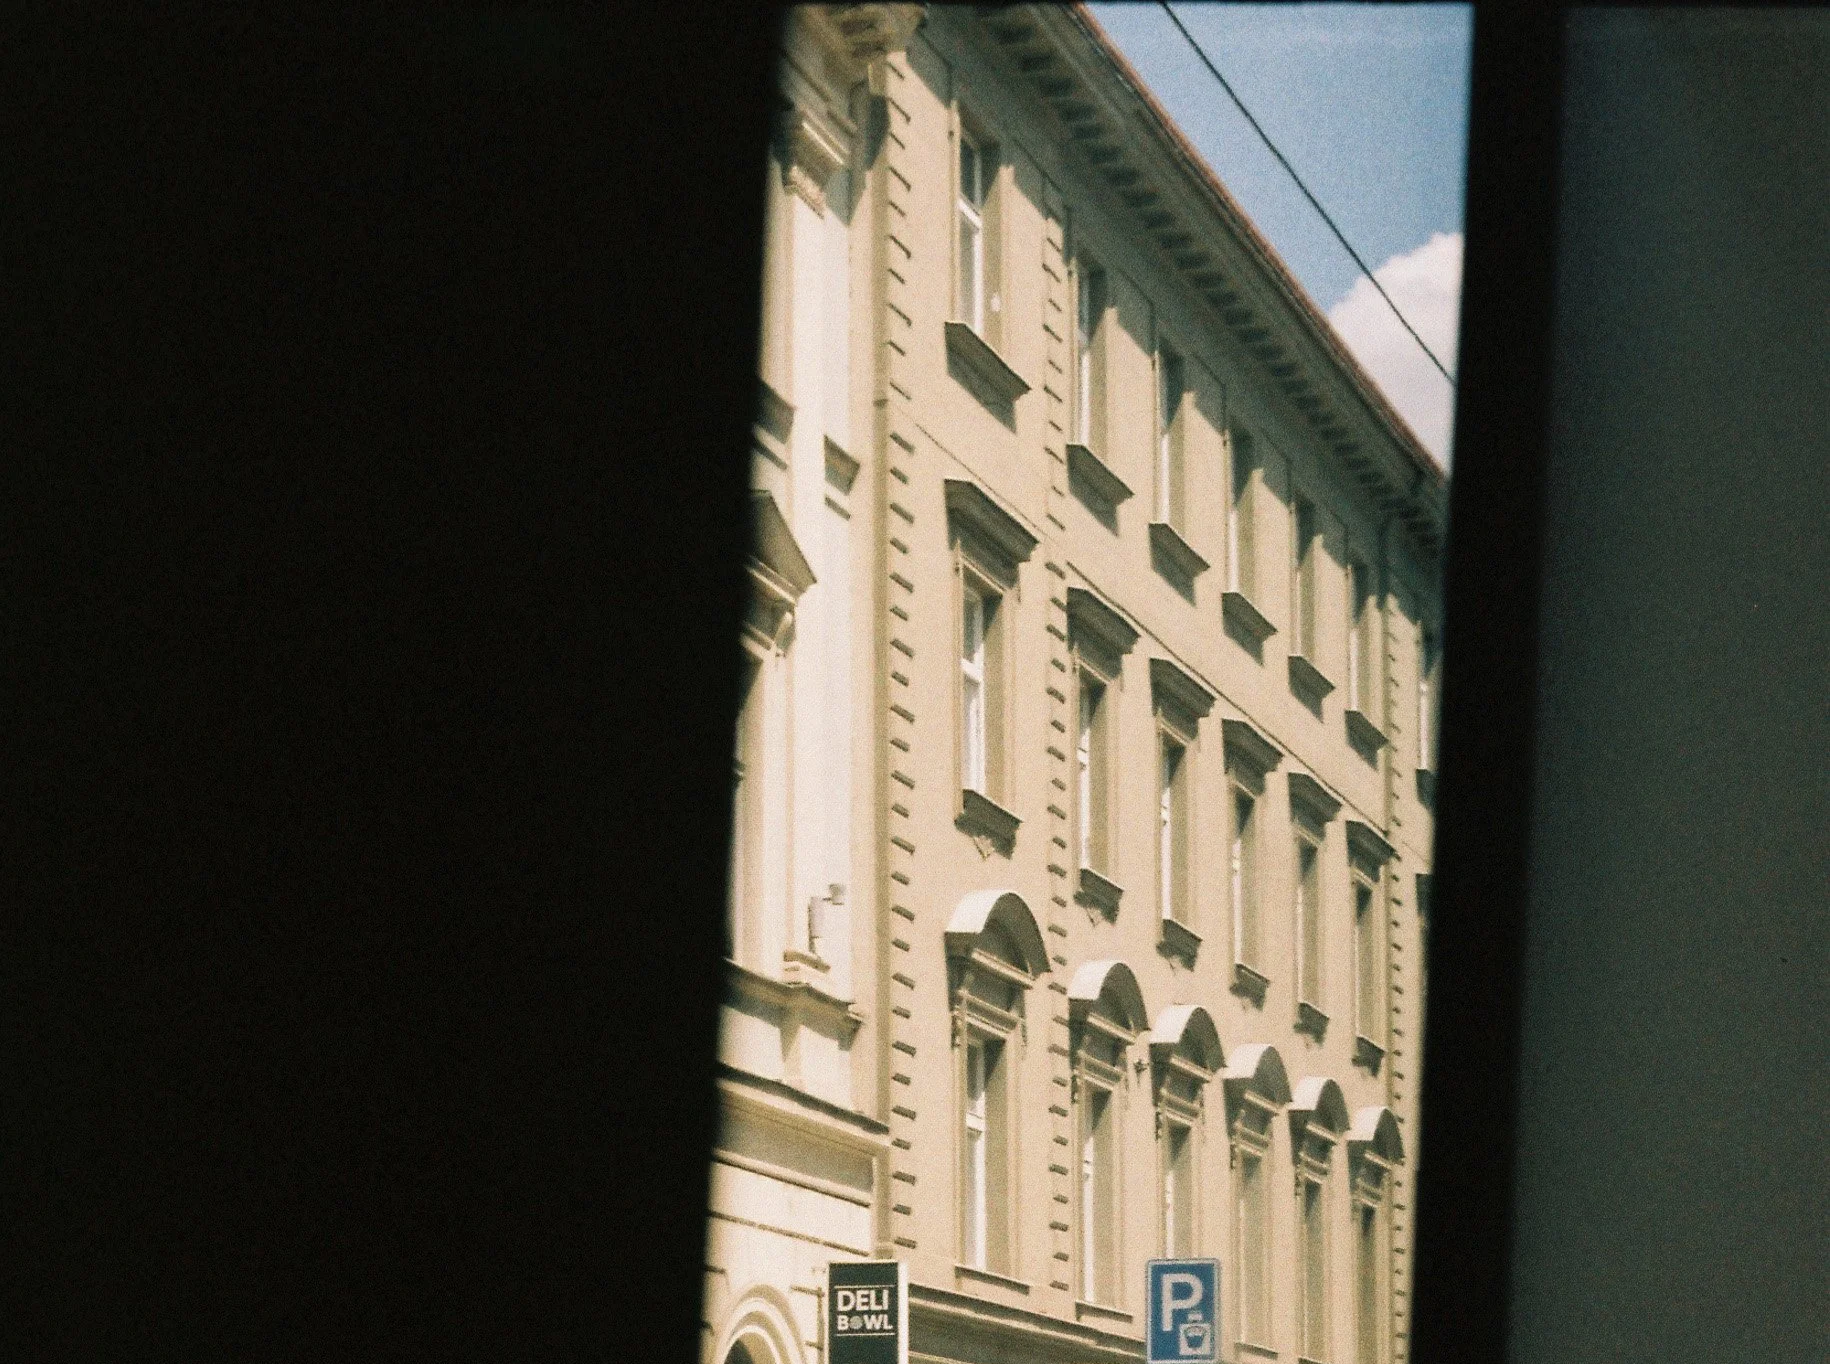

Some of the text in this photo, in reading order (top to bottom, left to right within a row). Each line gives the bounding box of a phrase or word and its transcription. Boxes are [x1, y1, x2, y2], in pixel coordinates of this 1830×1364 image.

[837, 1290, 890, 1311] DELI
[1161, 1273, 1203, 1332] P
[837, 1314, 894, 1331] BOWL
